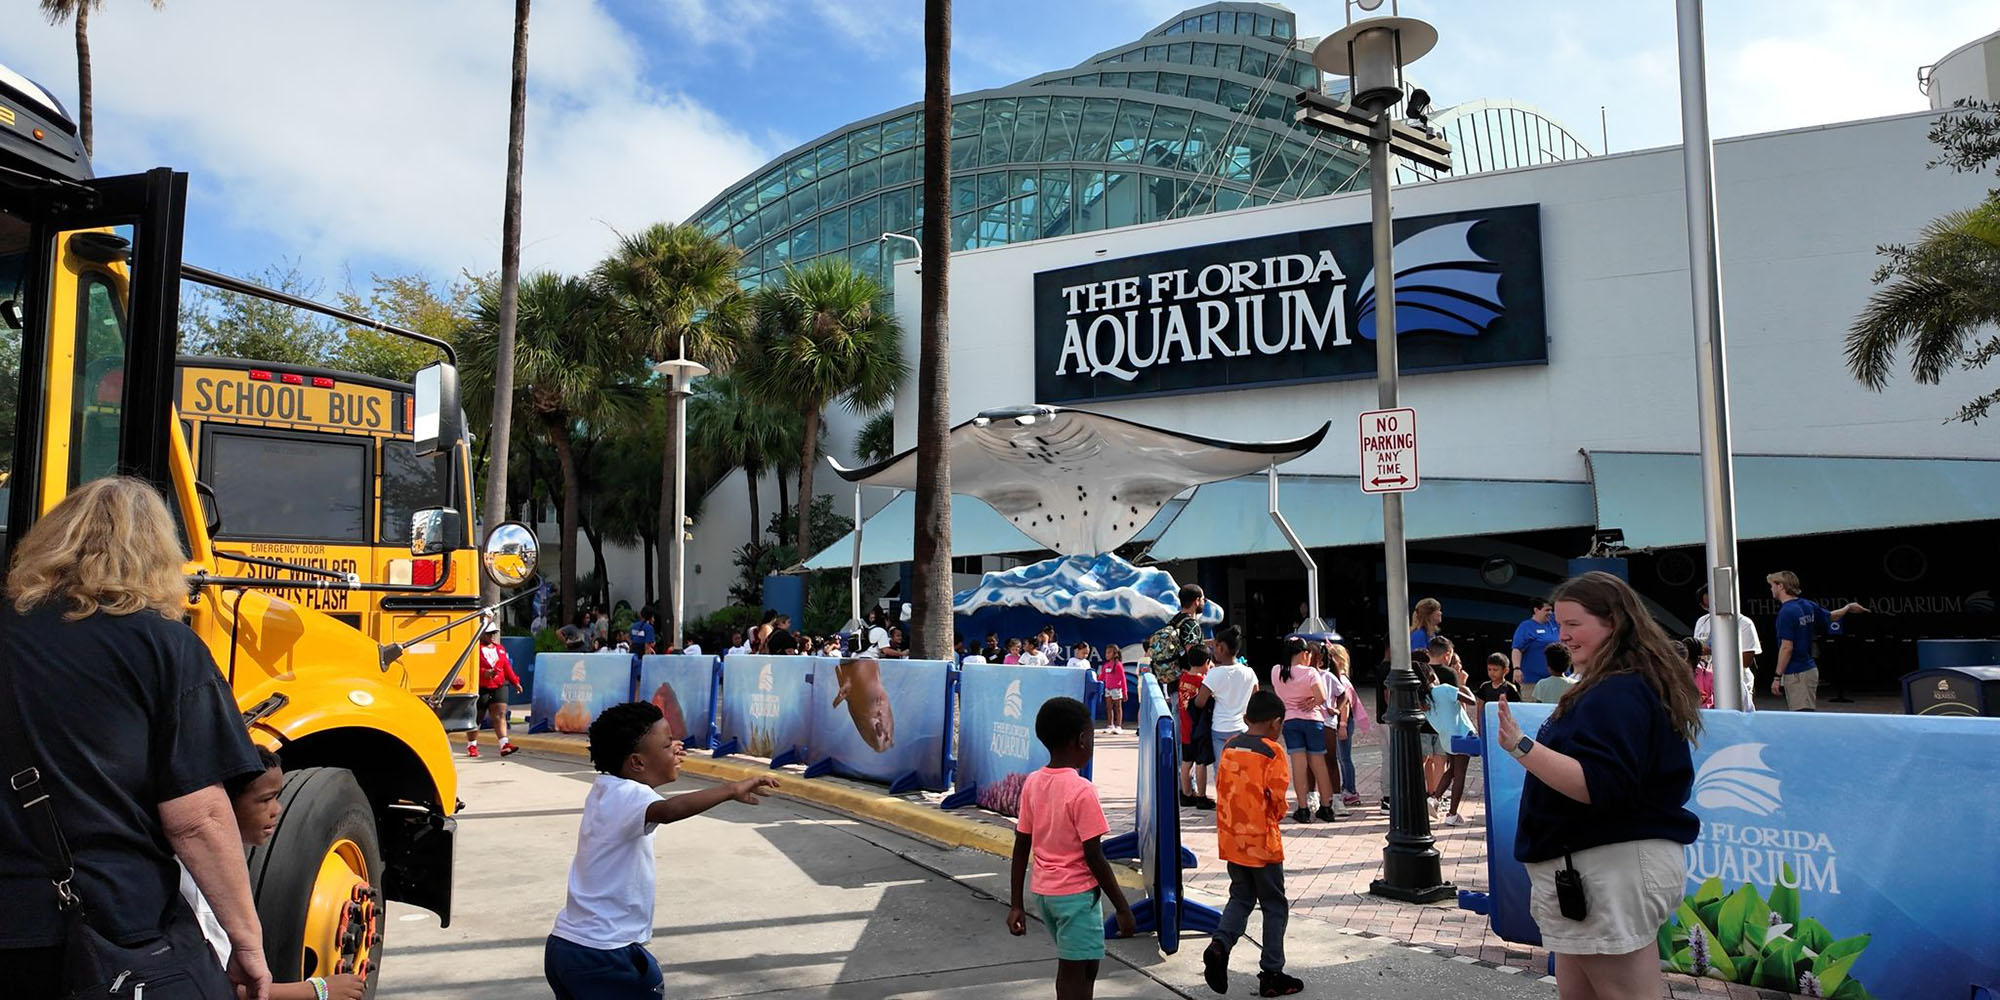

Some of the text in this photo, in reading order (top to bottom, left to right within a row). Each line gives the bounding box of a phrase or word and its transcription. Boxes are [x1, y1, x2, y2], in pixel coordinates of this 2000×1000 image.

[1062, 250, 1346, 315] THE FLORIDA
[1055, 284, 1352, 381] AQUARIUM
[194, 378, 381, 427] SCHOOL BUS
[1376, 416, 1398, 432] NO
[1364, 433, 1413, 452] PARKING
[1376, 450, 1402, 463] ANY
[1377, 463, 1401, 475] TIME
[251, 543, 325, 554] EMERGENCY DOOR
[306, 589, 348, 610] FLASH
[1868, 596, 1963, 616] AQUARIUM
[989, 732, 1029, 760] AQUARIUM
[1711, 822, 1836, 853] FLORIDA
[1684, 842, 1841, 895] QUARIUM
